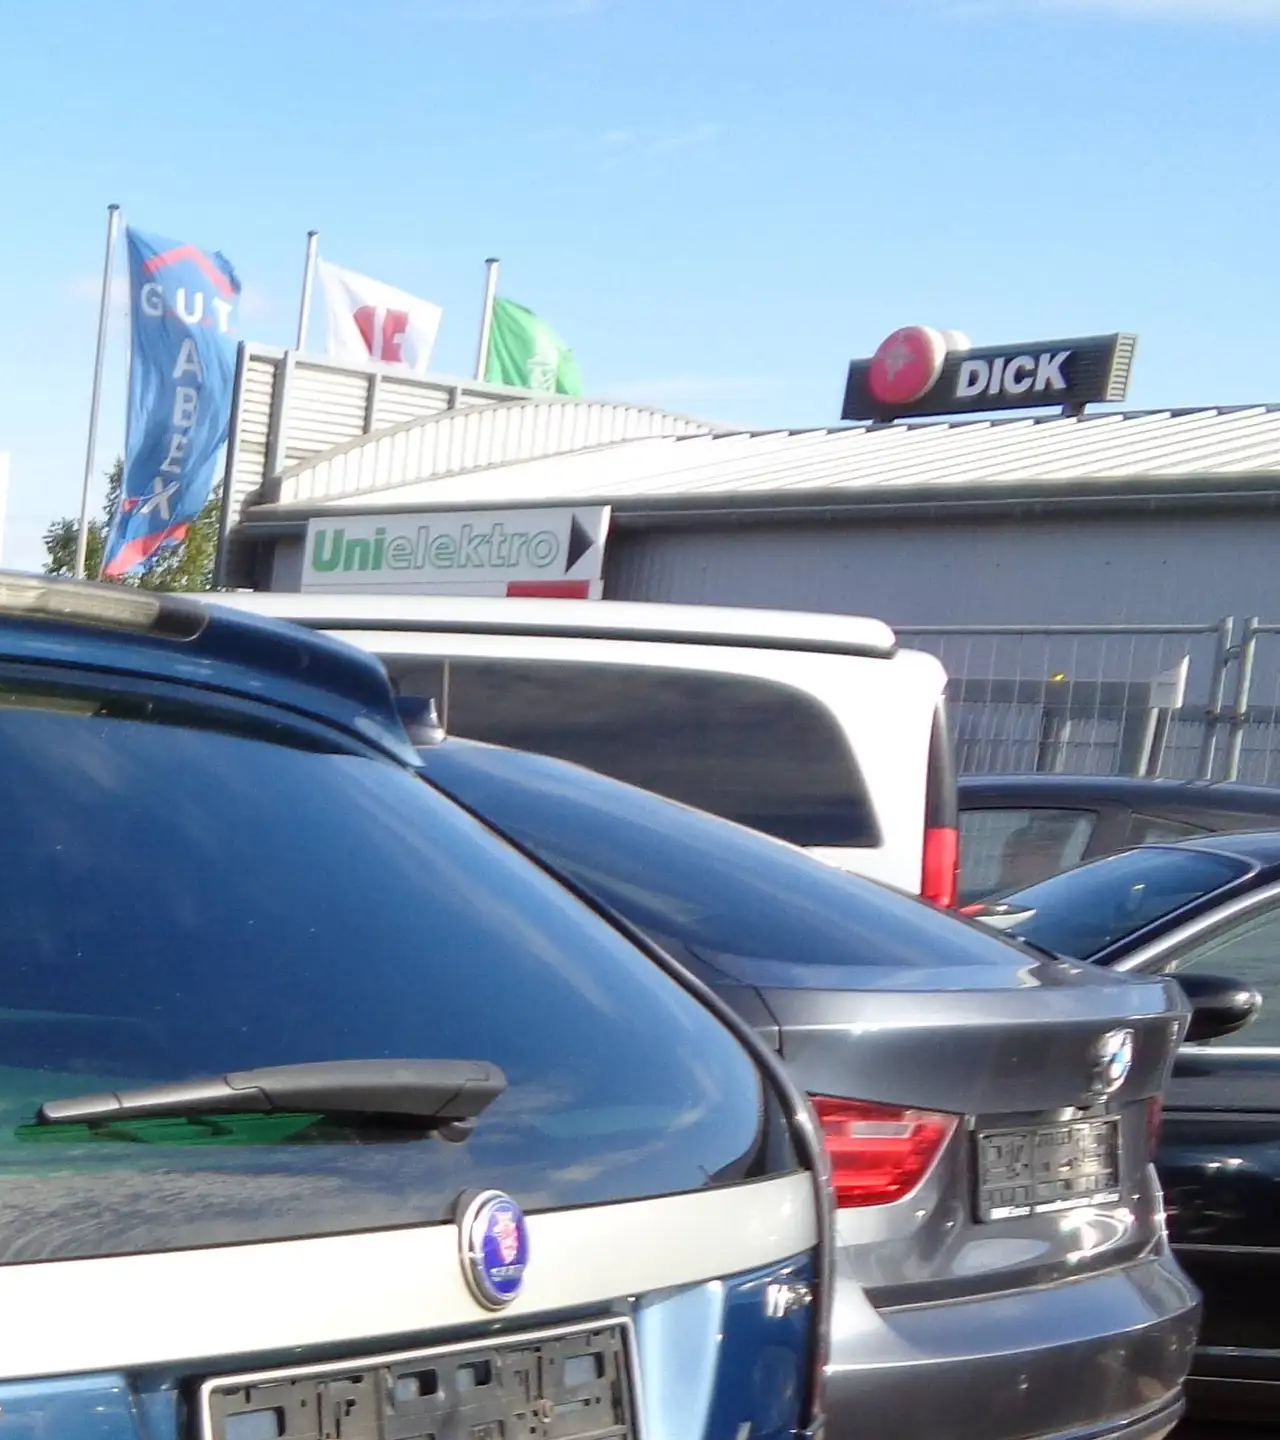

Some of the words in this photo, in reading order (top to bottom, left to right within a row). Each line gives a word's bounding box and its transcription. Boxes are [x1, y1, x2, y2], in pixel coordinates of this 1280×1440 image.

[956, 350, 1073, 397] DICK
[139, 337, 203, 520] ABEX
[311, 522, 560, 573] Unielektro
